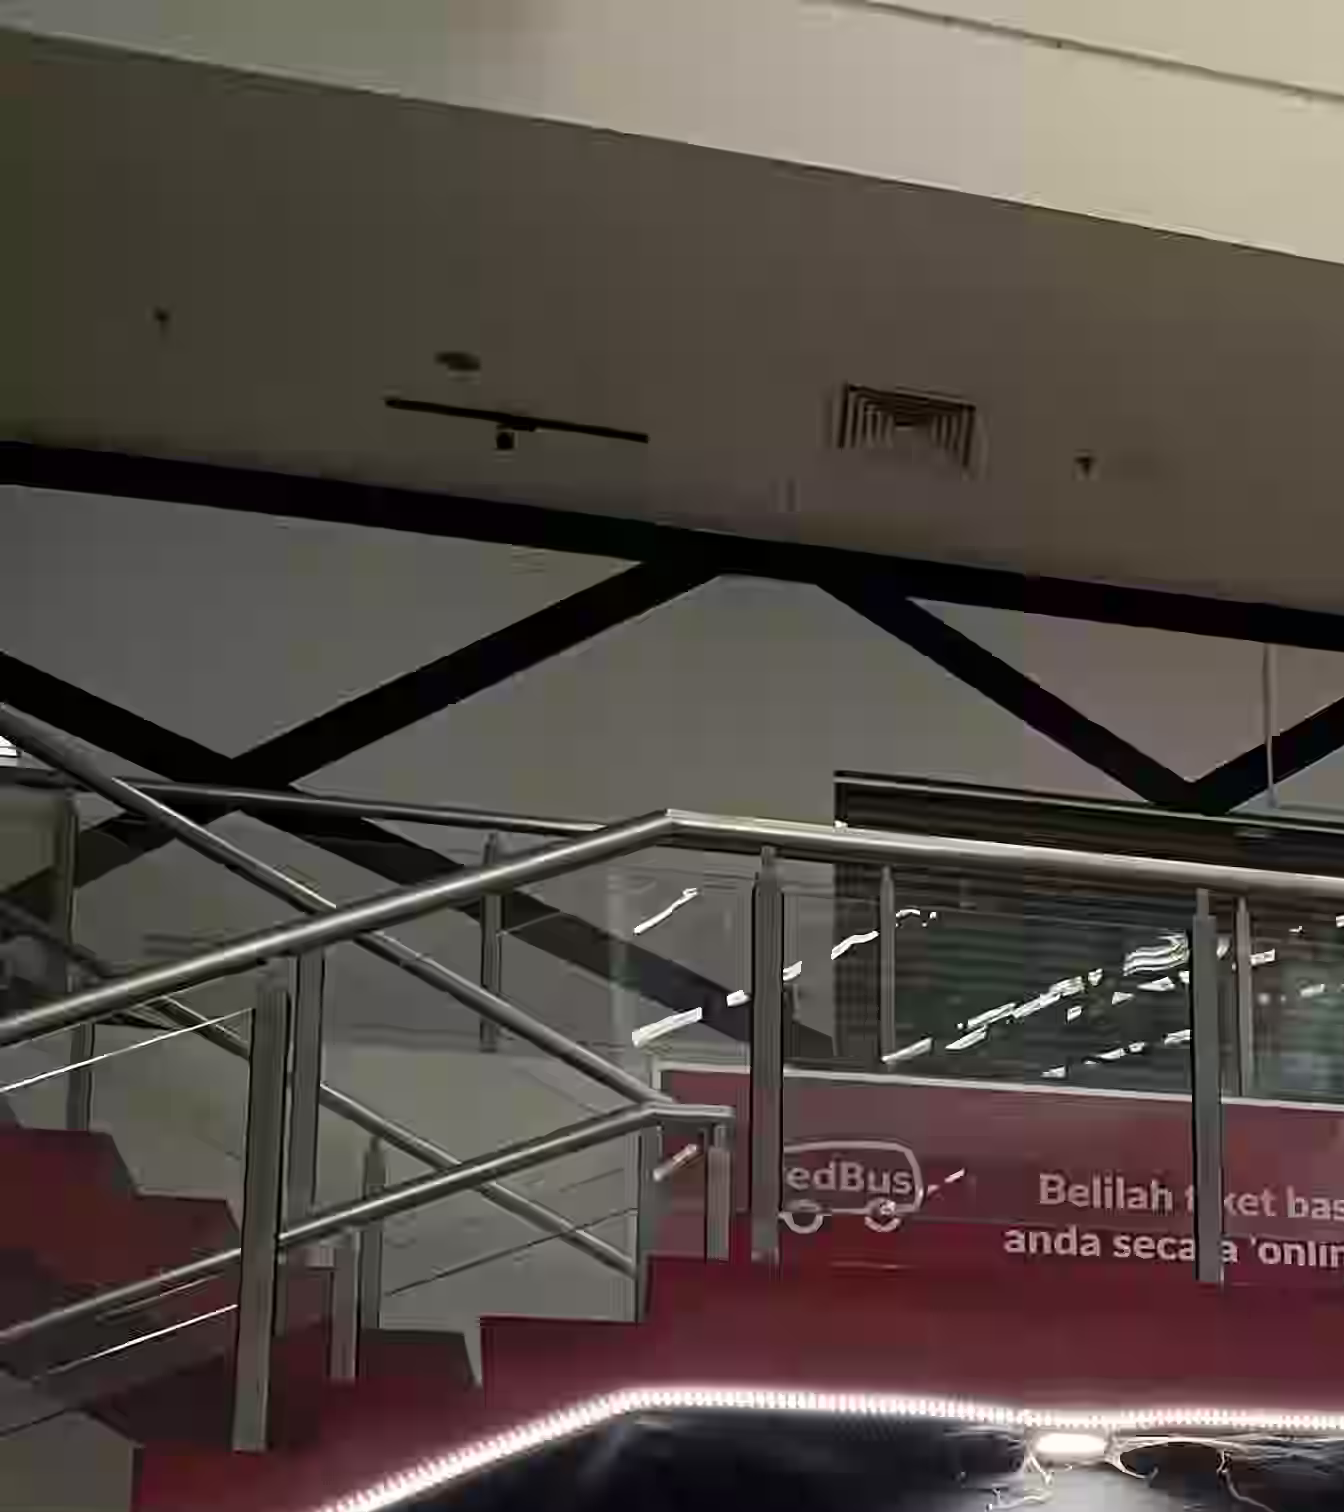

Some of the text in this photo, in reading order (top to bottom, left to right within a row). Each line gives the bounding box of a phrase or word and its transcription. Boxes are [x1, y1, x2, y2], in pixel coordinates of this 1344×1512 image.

[784, 1161, 913, 1195] edBus
[1039, 1171, 1173, 1212] Belilah
[1184, 1185, 1276, 1217] tket
[1004, 1225, 1101, 1257] anda
[1113, 1234, 1238, 1263] secaa
